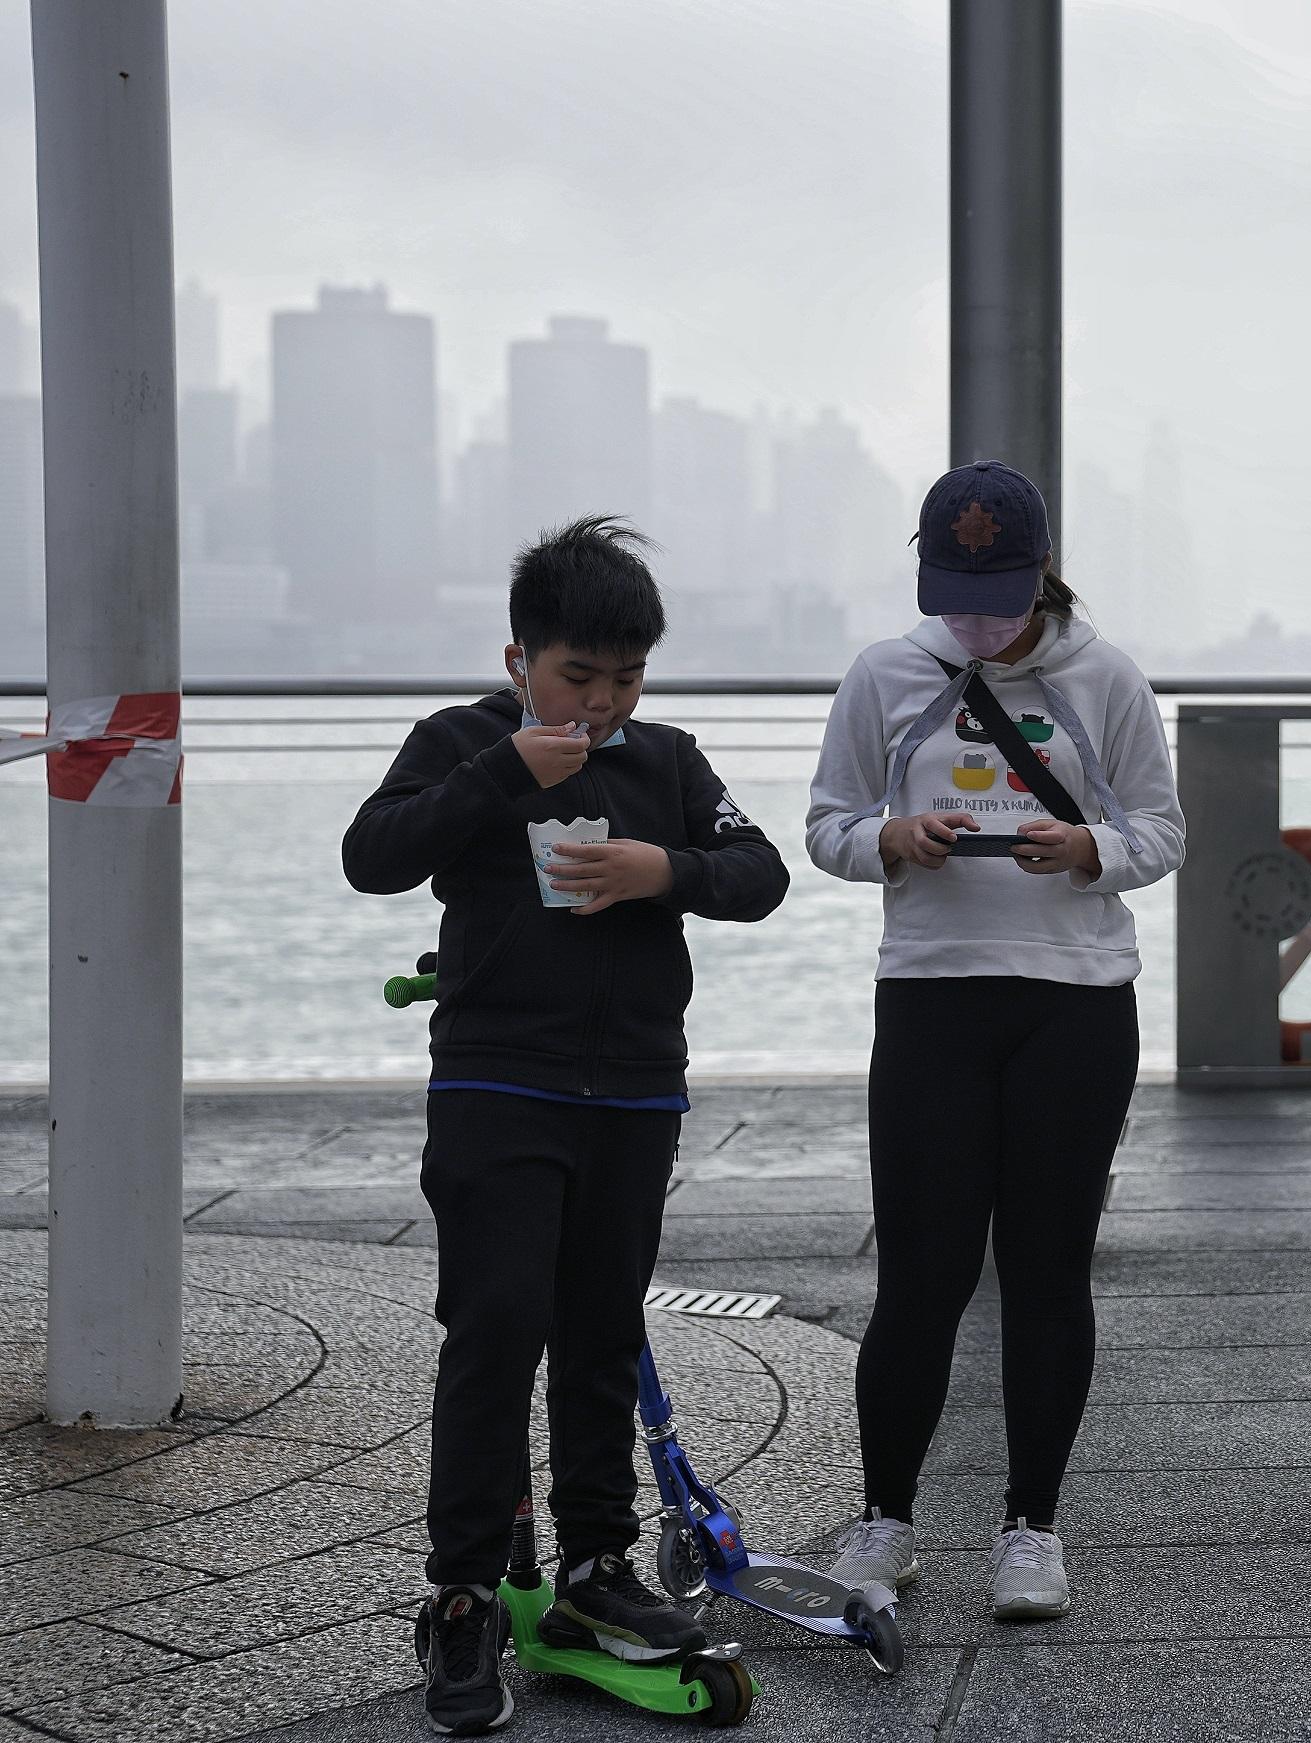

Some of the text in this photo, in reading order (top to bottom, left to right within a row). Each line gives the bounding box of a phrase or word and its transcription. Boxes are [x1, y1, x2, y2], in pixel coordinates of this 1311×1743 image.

[932, 797, 1048, 814] HELLO KITTY X KUMA
